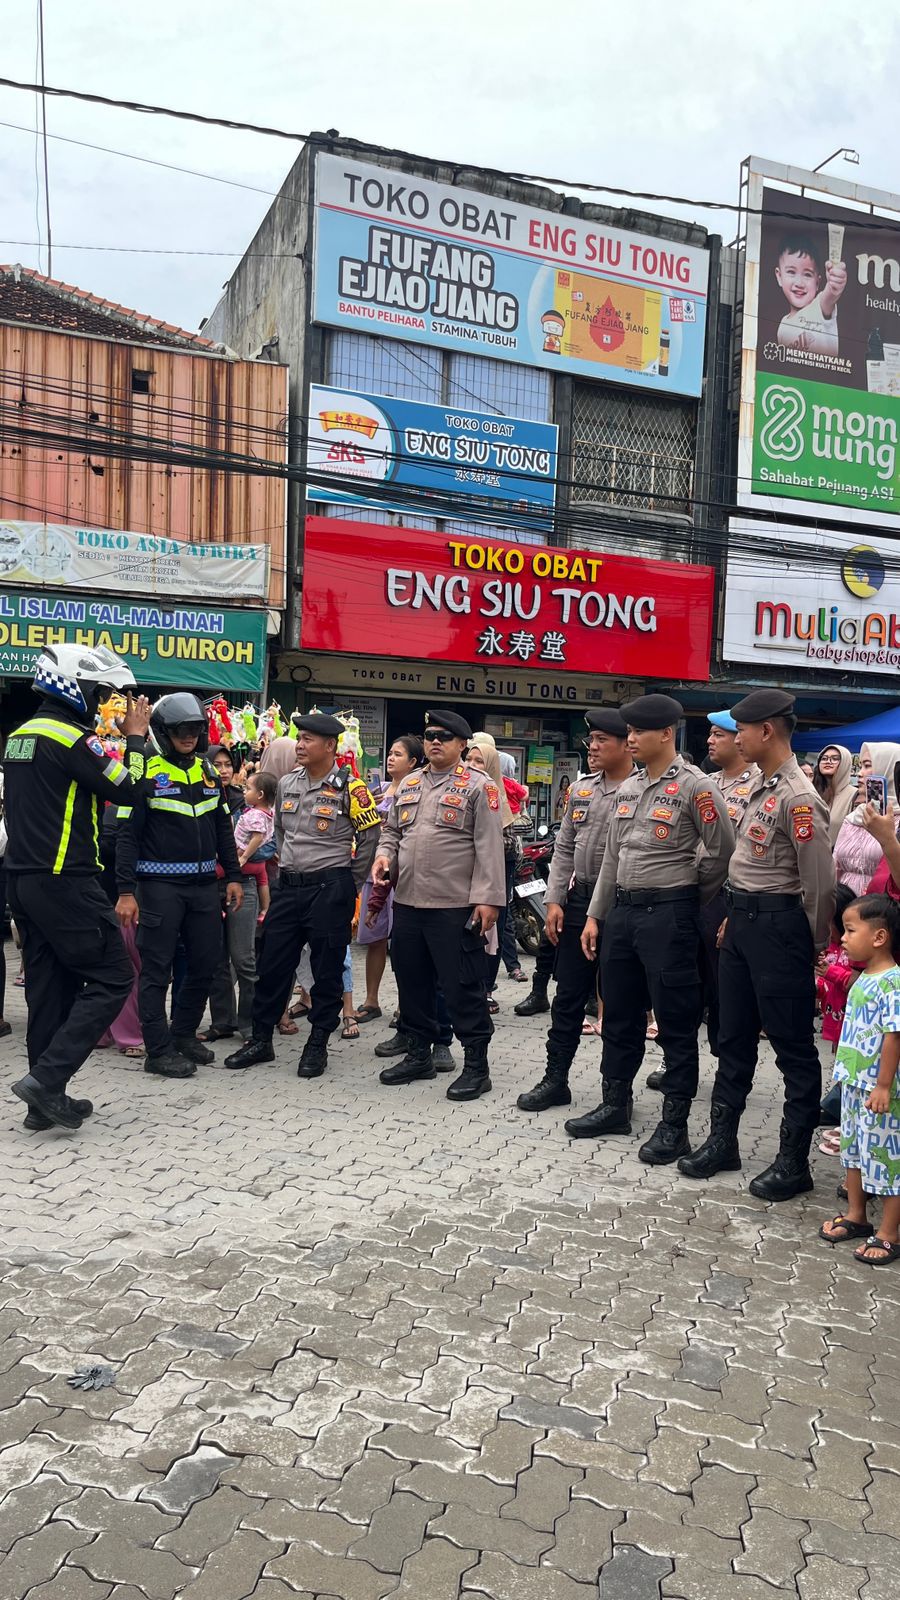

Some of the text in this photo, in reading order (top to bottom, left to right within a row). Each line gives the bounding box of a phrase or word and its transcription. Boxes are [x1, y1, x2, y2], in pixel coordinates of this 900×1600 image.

[343, 172, 691, 283] TOKO OBAT ENG SIU TONG
[370, 227, 494, 290] FUFANG
[340, 258, 518, 330] EJIAO JIANG
[865, 294, 900, 316] health
[338, 303, 518, 349] BANTU PELIHARA STAMINA TUBUH
[565, 309, 649, 335] FUFANG EJIAO JIANG
[786, 348, 845, 367] MENYEHATKAN
[786, 356, 815, 368] MENUTRISI
[815, 361, 832, 371] KULIT
[446, 415, 514, 436] TOKO OBAT
[812, 404, 897, 443] mom
[406, 429, 550, 474] ENG SIU TONG
[760, 467, 895, 500] Sahabat Pejuang ASI
[75, 531, 258, 560] TOKO ASIA AFRIKA
[78, 551, 105, 561] SEDIA
[449, 541, 603, 583] TOKO OBAT
[20, 598, 85, 621] ISLAM
[386, 568, 657, 633] ENG SIU TONG
[76, 628, 147, 660] HAJI,
[156, 635, 254, 664] UMROH
[477, 625, 567, 661] 永寿堂
[352, 669, 578, 701] TOKO OBAT ENG SIU TONG
[444, 786, 471, 795] POLRI
[653, 796, 682, 808] POLRI
[755, 811, 777, 826] POLRI
